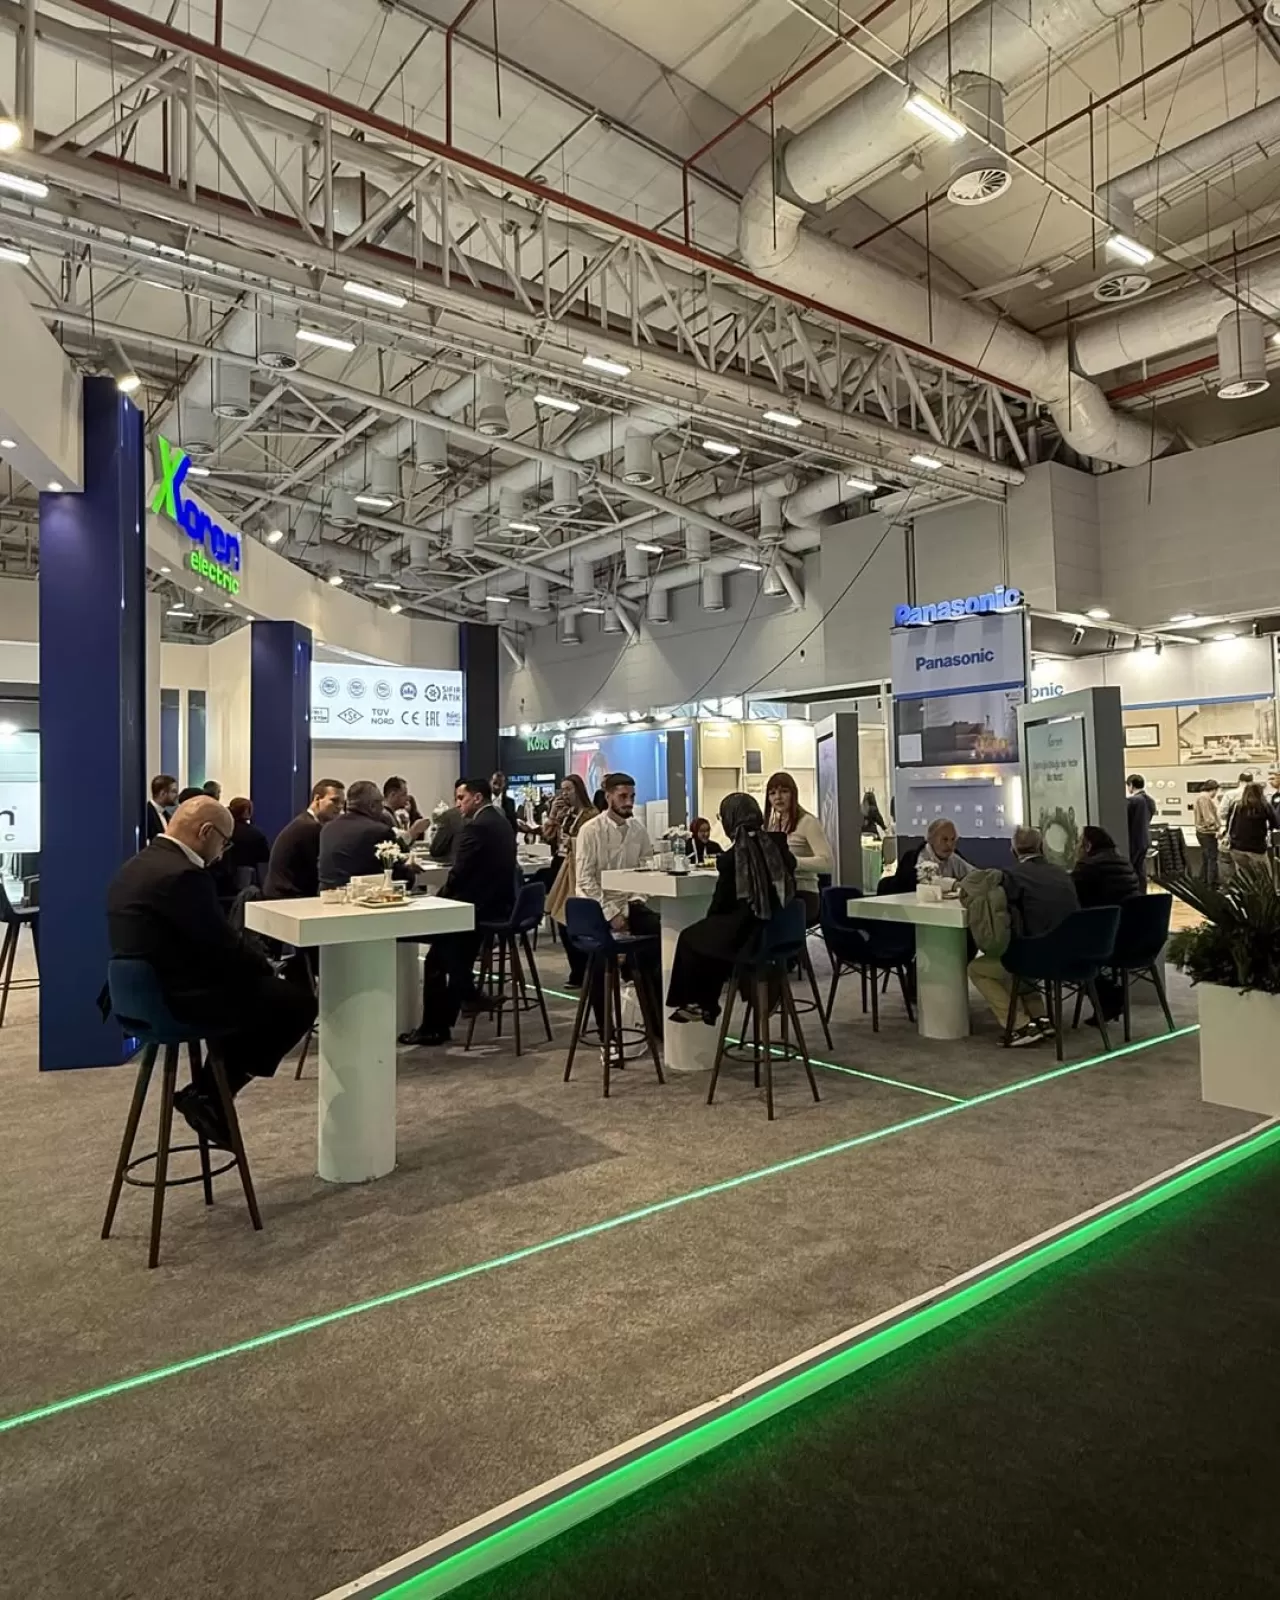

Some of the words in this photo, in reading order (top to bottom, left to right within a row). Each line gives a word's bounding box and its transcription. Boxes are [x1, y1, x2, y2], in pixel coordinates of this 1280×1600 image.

[189, 550, 240, 595] electric
[895, 584, 1023, 627] Panasonic
[915, 648, 995, 672] Panasonic
[371, 717, 395, 725] NORD
[401, 710, 420, 725] CE
